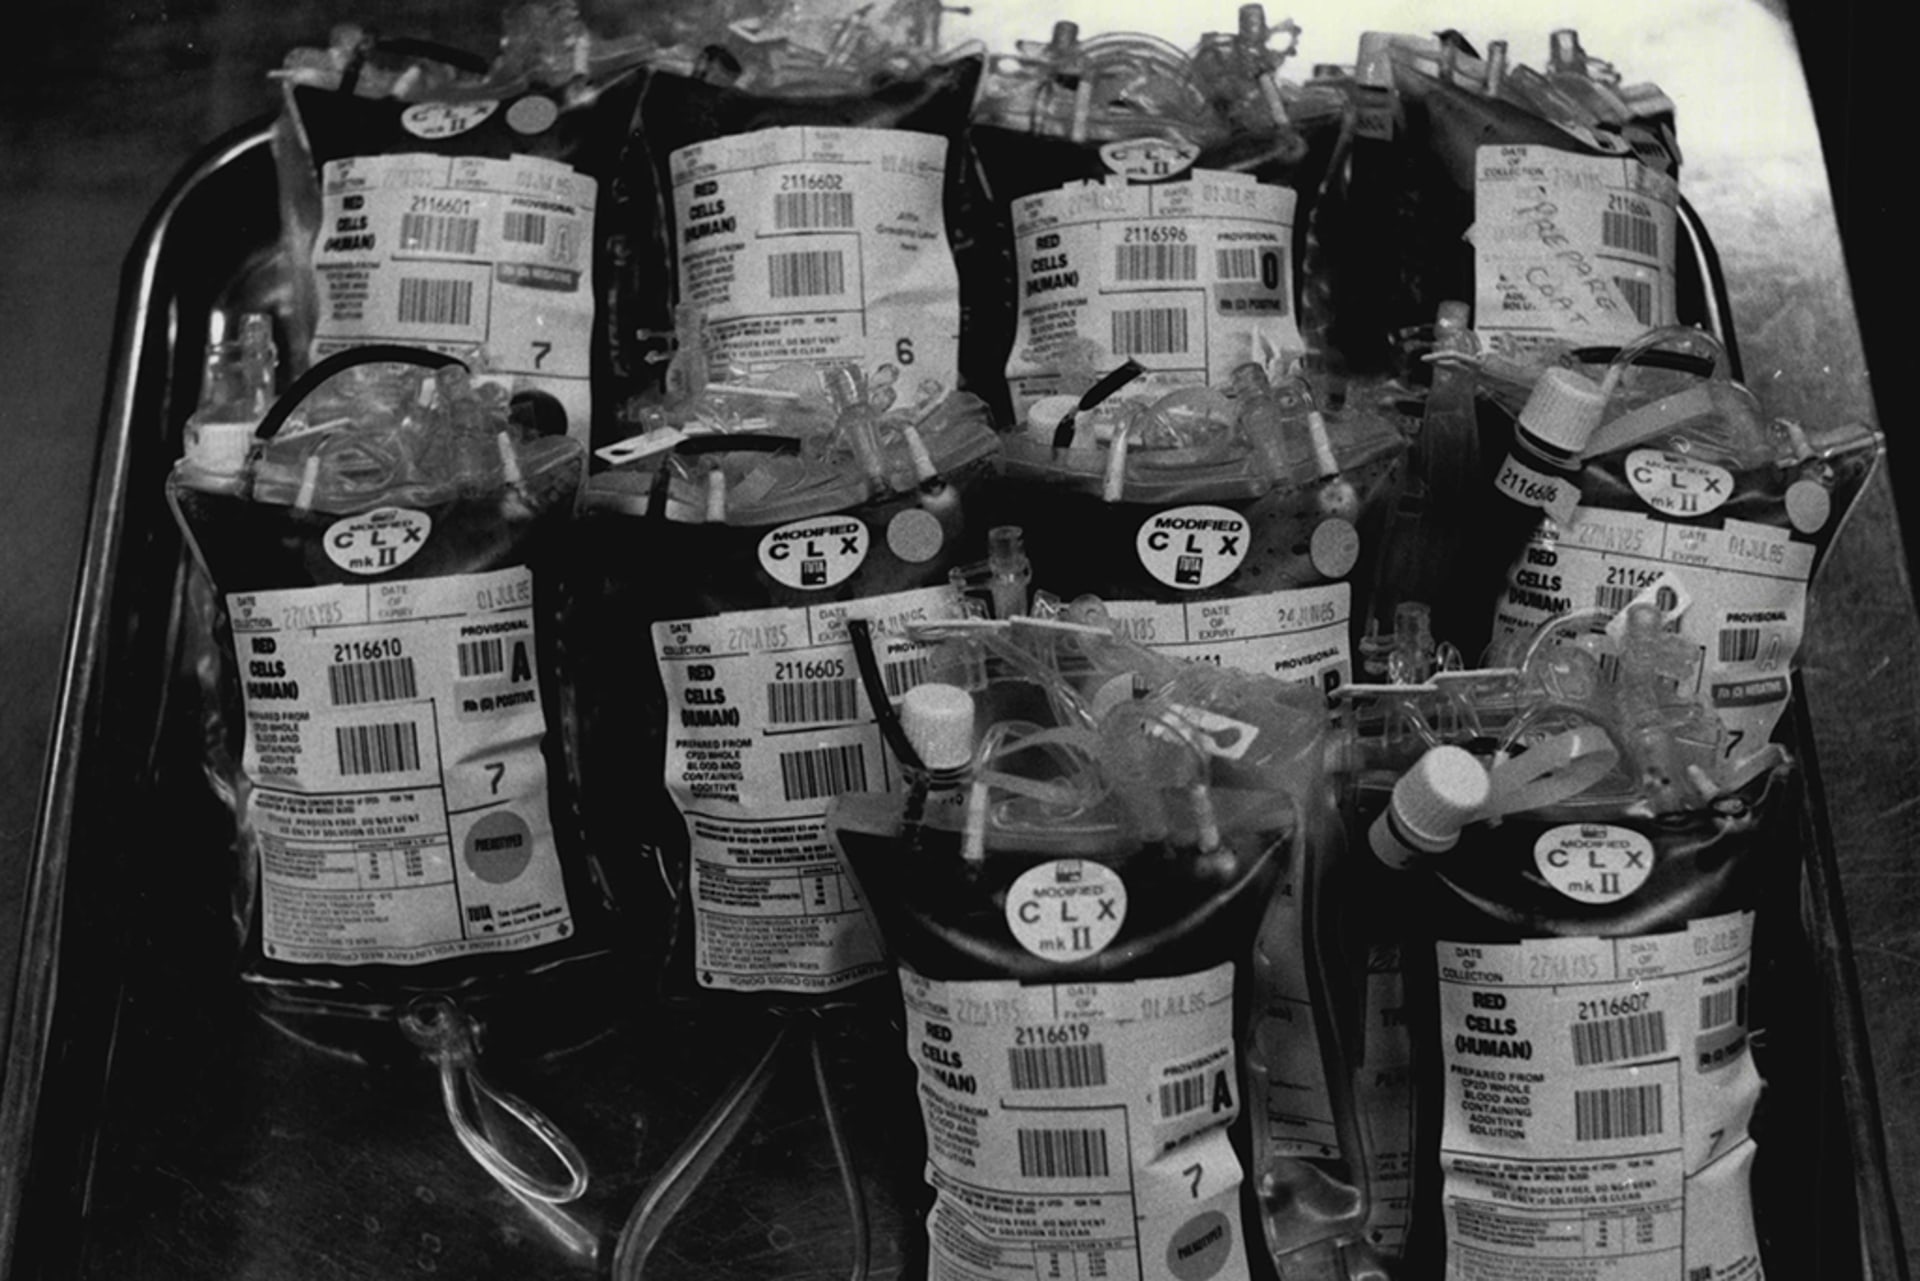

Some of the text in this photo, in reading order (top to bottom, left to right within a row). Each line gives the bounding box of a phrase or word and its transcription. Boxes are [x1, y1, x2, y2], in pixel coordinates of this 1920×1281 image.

[693, 180, 719, 198] RED
[780, 173, 843, 191] 2116602
[343, 195, 364, 210] RED
[410, 195, 471, 214] 2116601
[689, 199, 726, 221] CELLS
[336, 214, 368, 233] CELLS
[1036, 233, 1061, 251] RED
[1124, 226, 1188, 242] 2116596
[1217, 231, 1279, 242] PROVISIONAL
[1031, 253, 1068, 274] CELLS
[530, 341, 552, 369] 7
[896, 338, 914, 366] 6
[772, 523, 859, 542] MODIFIED
[1155, 517, 1243, 531] MODIFIED
[1527, 548, 1558, 567] RED
[1516, 569, 1562, 592] CELLS
[1203, 605, 1231, 618] DATE
[1726, 611, 1787, 623] PROVISIONAL
[460, 619, 529, 637] PROVISIONAL
[1209, 617, 1224, 628] OF
[1199, 628, 1236, 640] EXPIRY
[252, 637, 276, 654] RED
[334, 637, 402, 663] 2116610
[511, 641, 532, 683] A
[1275, 647, 1340, 671] PROVISIONAL
[249, 660, 287, 678] CELLS
[687, 664, 716, 681] RED
[775, 658, 845, 680] 2116605
[684, 687, 727, 706] CELLS
[1724, 730, 1744, 759] 7
[485, 762, 505, 794] 7
[1560, 839, 1631, 850] MODIFIED
[1033, 885, 1104, 898] MODIFIED
[1568, 872, 1621, 894] mk II
[1040, 926, 1093, 951] mk II
[1456, 946, 1482, 959] DATE
[1462, 959, 1477, 969] OF
[1442, 966, 1503, 983] COLLECTION
[1473, 991, 1507, 1010] RED
[1578, 991, 1650, 1020] 2116607
[926, 1021, 953, 1043] RED
[1015, 1023, 1090, 1045] 2116619
[1465, 1013, 1518, 1036] CELLS
[922, 1042, 963, 1069] CELLS
[1455, 1033, 1533, 1060] (HUMAN)
[1163, 1047, 1229, 1076] PROVISIONAL
[1450, 1064, 1544, 1083] PREPARED FROM
[1212, 1069, 1233, 1114] A
[1463, 1089, 1530, 1105] BLOOD AND
[1489, 1082, 1530, 1094] WHOLE
[1461, 1100, 1532, 1117] CONTAINING
[1470, 1113, 1523, 1127] ADDITIVE
[1469, 1123, 1525, 1139] SOLUTION
[1710, 1128, 1725, 1158] 7
[1183, 1163, 1203, 1198] 7
